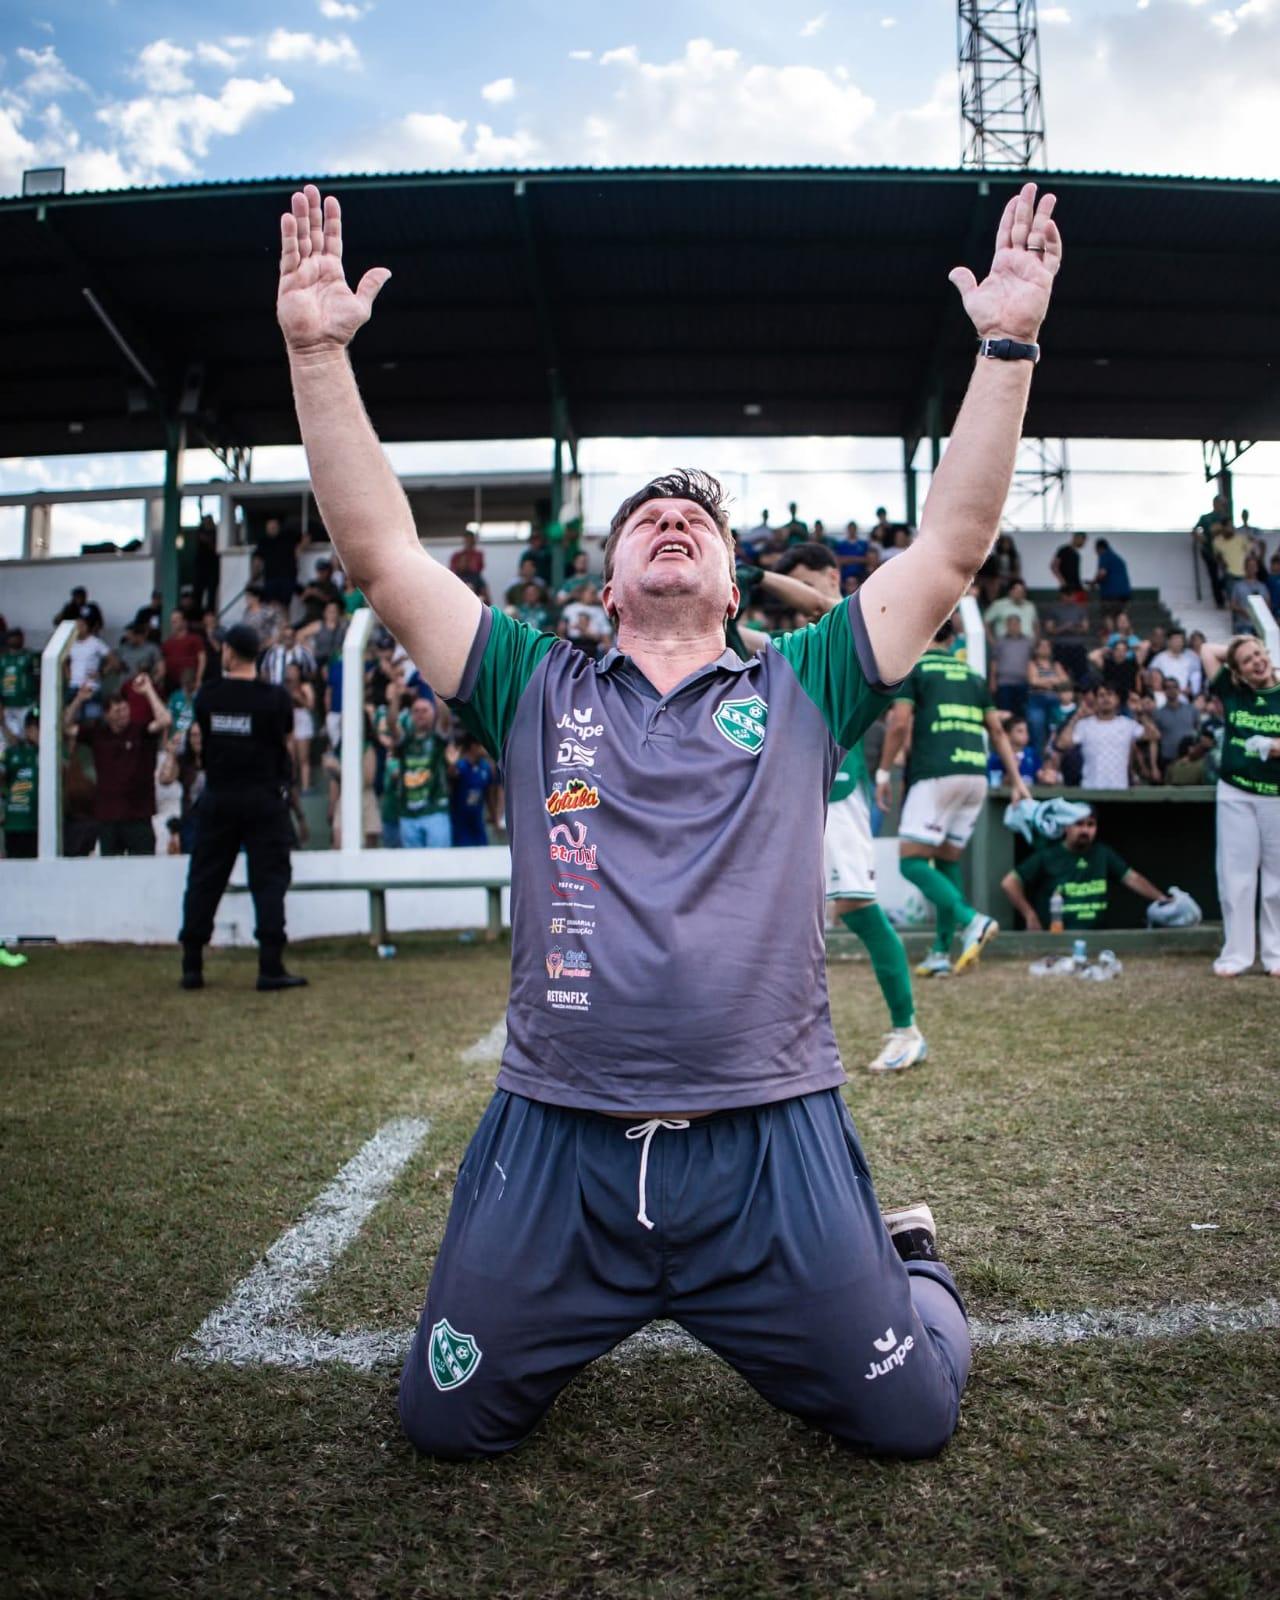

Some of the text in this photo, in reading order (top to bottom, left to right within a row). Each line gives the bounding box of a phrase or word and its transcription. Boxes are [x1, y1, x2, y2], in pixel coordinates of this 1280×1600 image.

[556, 713, 604, 740] Junpe
[547, 989, 589, 1005] RETENFIX
[864, 1334, 915, 1380] Junpe
